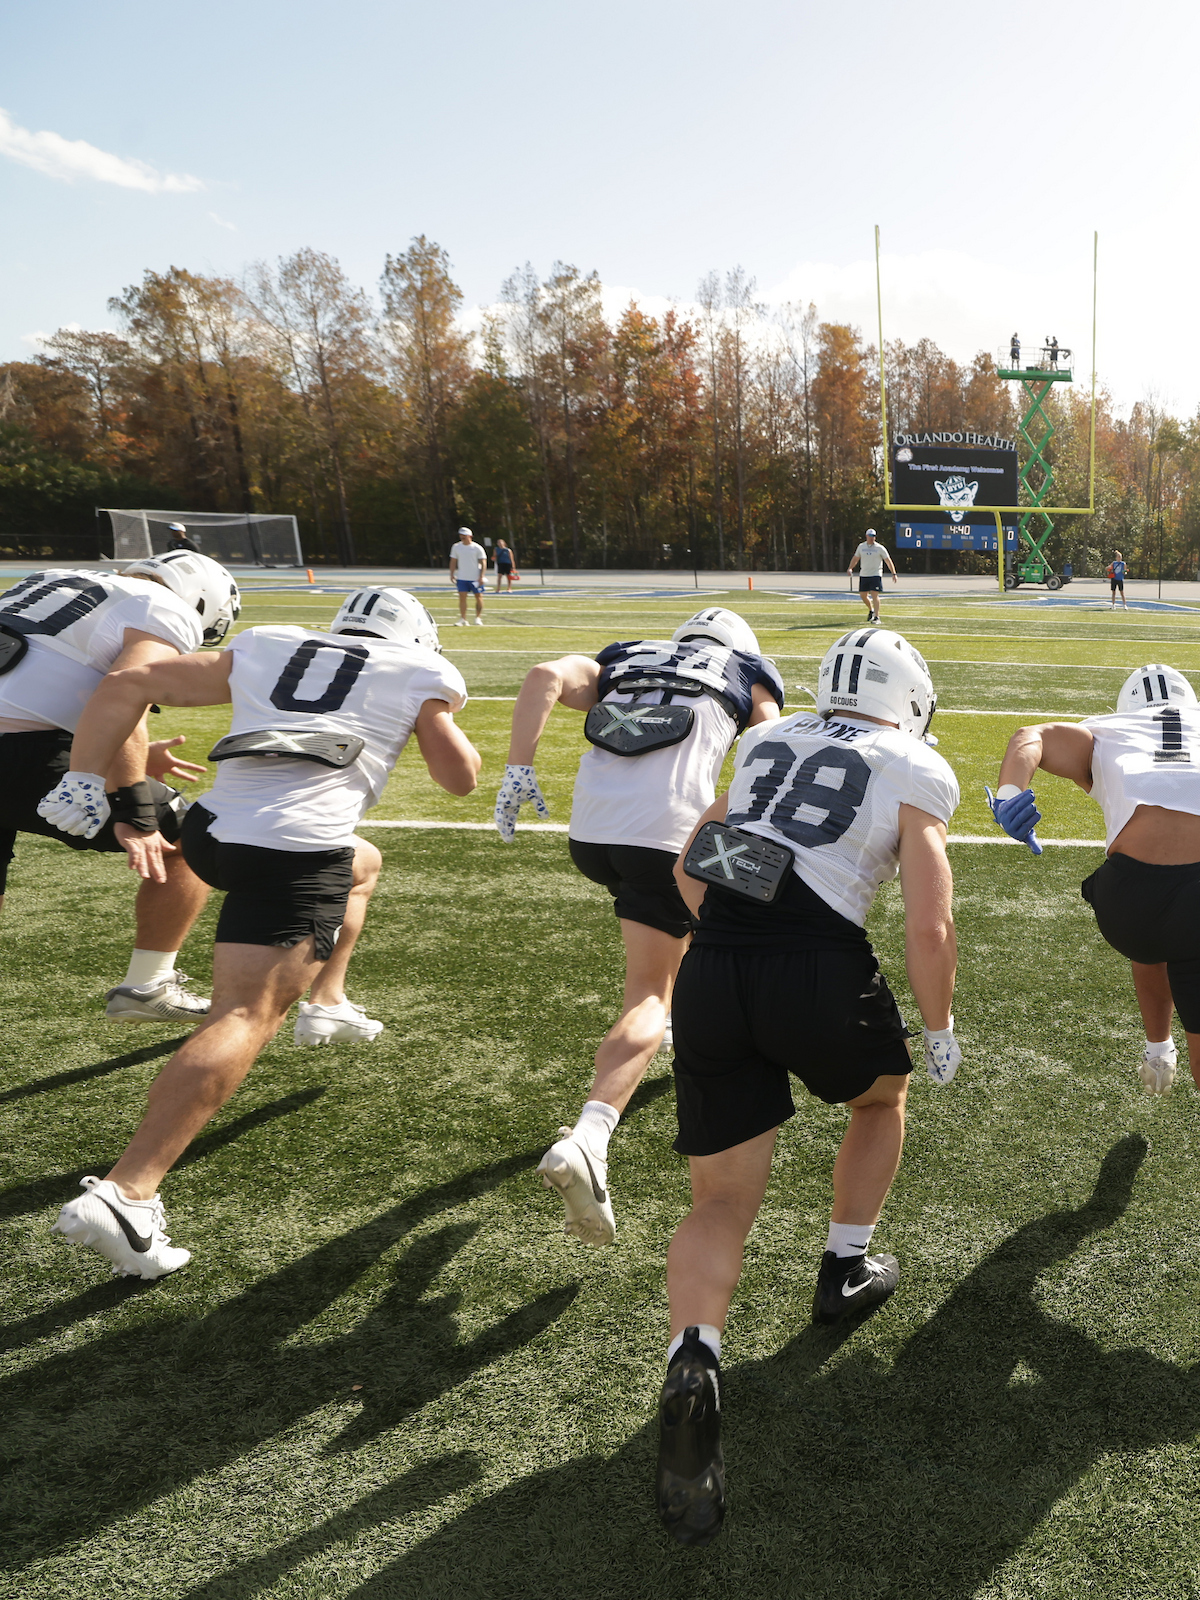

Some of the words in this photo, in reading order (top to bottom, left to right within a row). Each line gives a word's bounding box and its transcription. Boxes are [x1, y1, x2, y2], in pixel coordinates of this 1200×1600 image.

[894, 432, 963, 447] ORLANDO
[966, 432, 1016, 452] HEALTH
[947, 482, 964, 493] BYU
[905, 528, 912, 538] 0
[950, 525, 971, 535] 4:40
[1007, 530, 1014, 540] 0
[610, 640, 734, 692] 24
[269, 640, 370, 714] 0
[830, 696, 837, 705] GO
[838, 697, 858, 707] COUGS
[783, 718, 870, 742] PAYNE
[1153, 706, 1191, 763] 1
[724, 740, 872, 848] 38
